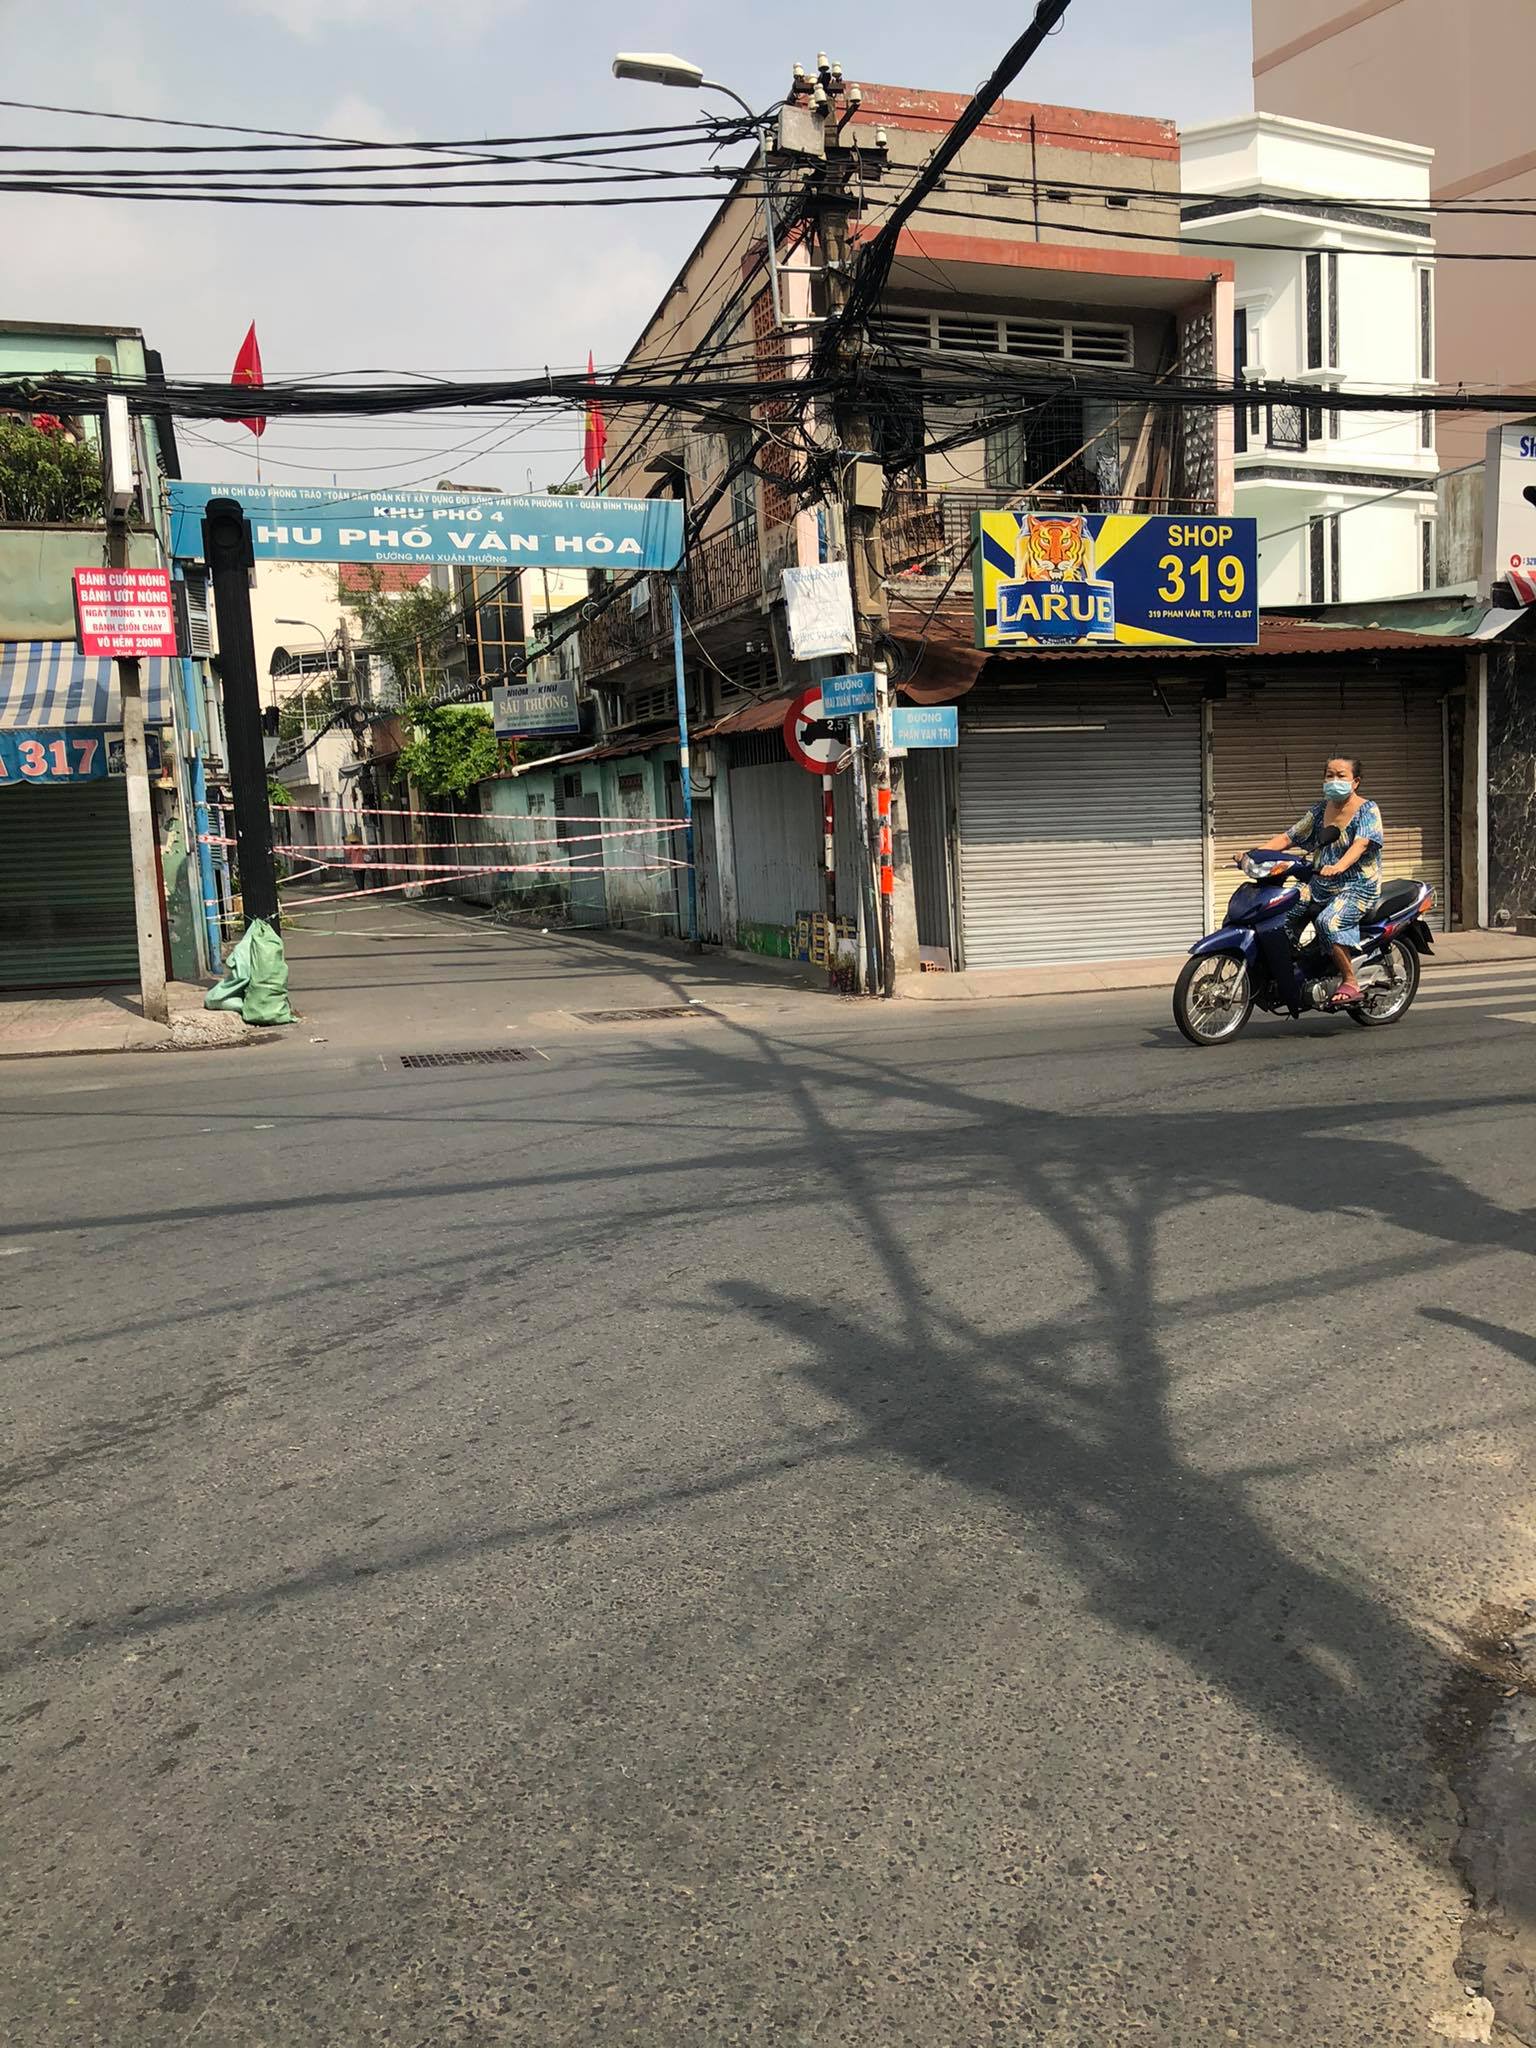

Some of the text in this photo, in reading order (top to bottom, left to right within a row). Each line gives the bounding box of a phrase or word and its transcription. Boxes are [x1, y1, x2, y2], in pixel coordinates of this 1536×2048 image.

[211, 486, 229, 496] BAN
[268, 488, 297, 498] PHONG
[565, 501, 574, 509] 11
[373, 505, 505, 522] KHU PHỐ 4
[252, 524, 644, 554] HU PHỐ VĂN HÓA
[1168, 524, 1233, 547] SHOP
[415, 552, 435, 562] MAI
[437, 552, 465, 562] XUÂN
[79, 570, 166, 587] BÁNH CUỐN NÓNG
[1157, 554, 1245, 603] 319
[80, 587, 168, 603] BÁNH ƯỚT NÓNG
[1050, 584, 1065, 594] BIA
[157, 609, 167, 618] 15
[1001, 593, 1112, 623] LARUE
[1148, 610, 1161, 618] 319
[1162, 610, 1184, 618] PHAN
[1185, 608, 1200, 618] VĂN
[1234, 610, 1252, 619] Q.BT
[142, 623, 163, 631] CHAY
[136, 637, 163, 648] 200M
[18, 740, 99, 777] 317
